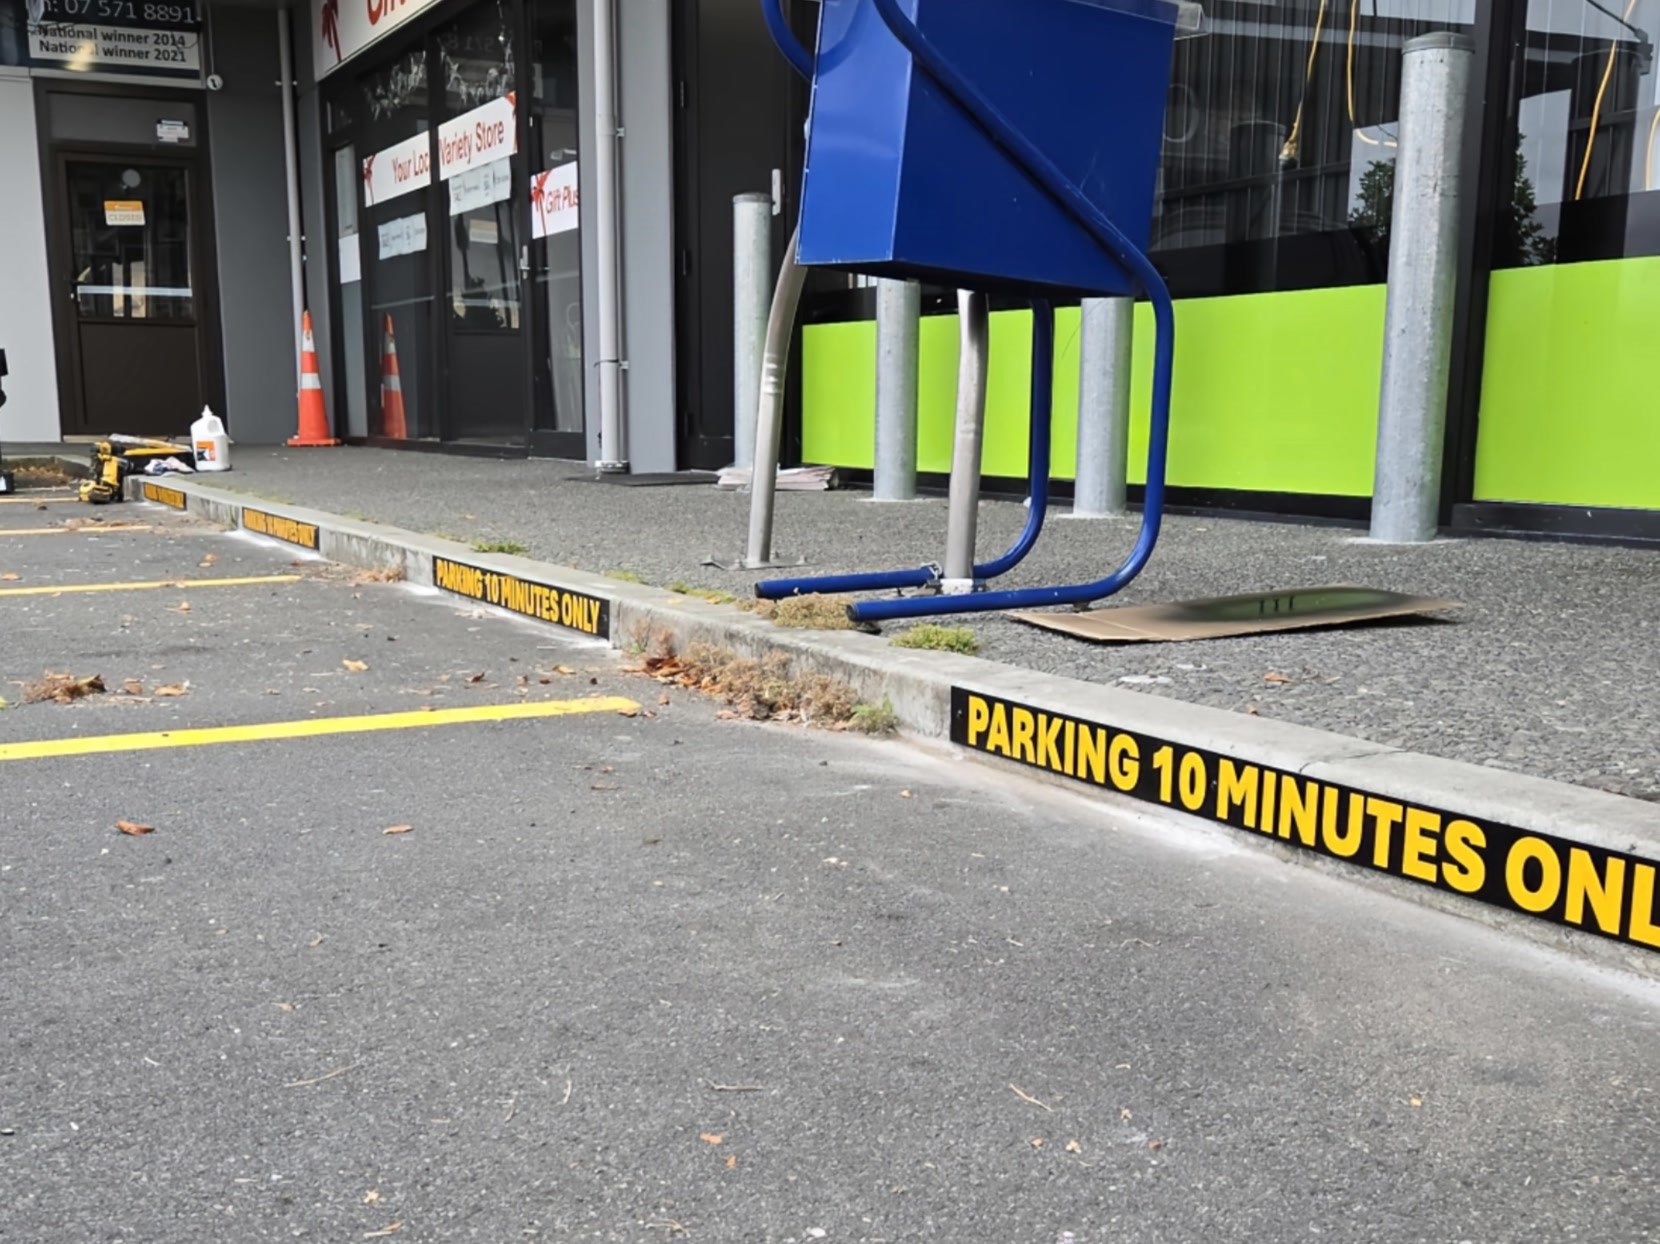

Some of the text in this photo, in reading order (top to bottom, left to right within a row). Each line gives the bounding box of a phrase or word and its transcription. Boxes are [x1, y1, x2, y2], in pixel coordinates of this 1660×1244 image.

[97, 0, 137, 19] 571
[143, 3, 195, 24] 8891
[38, 24, 98, 41] National
[101, 30, 149, 45] winner
[38, 40, 187, 63] Natiol winner 2021
[439, 120, 505, 166] Variety Store
[391, 156, 412, 184] Your
[436, 559, 600, 634] PARKING 10 MINUTES ONLY
[967, 695, 1141, 791] PARKING
[1152, 745, 1207, 811] 10
[1215, 758, 1487, 893] MINUTES
